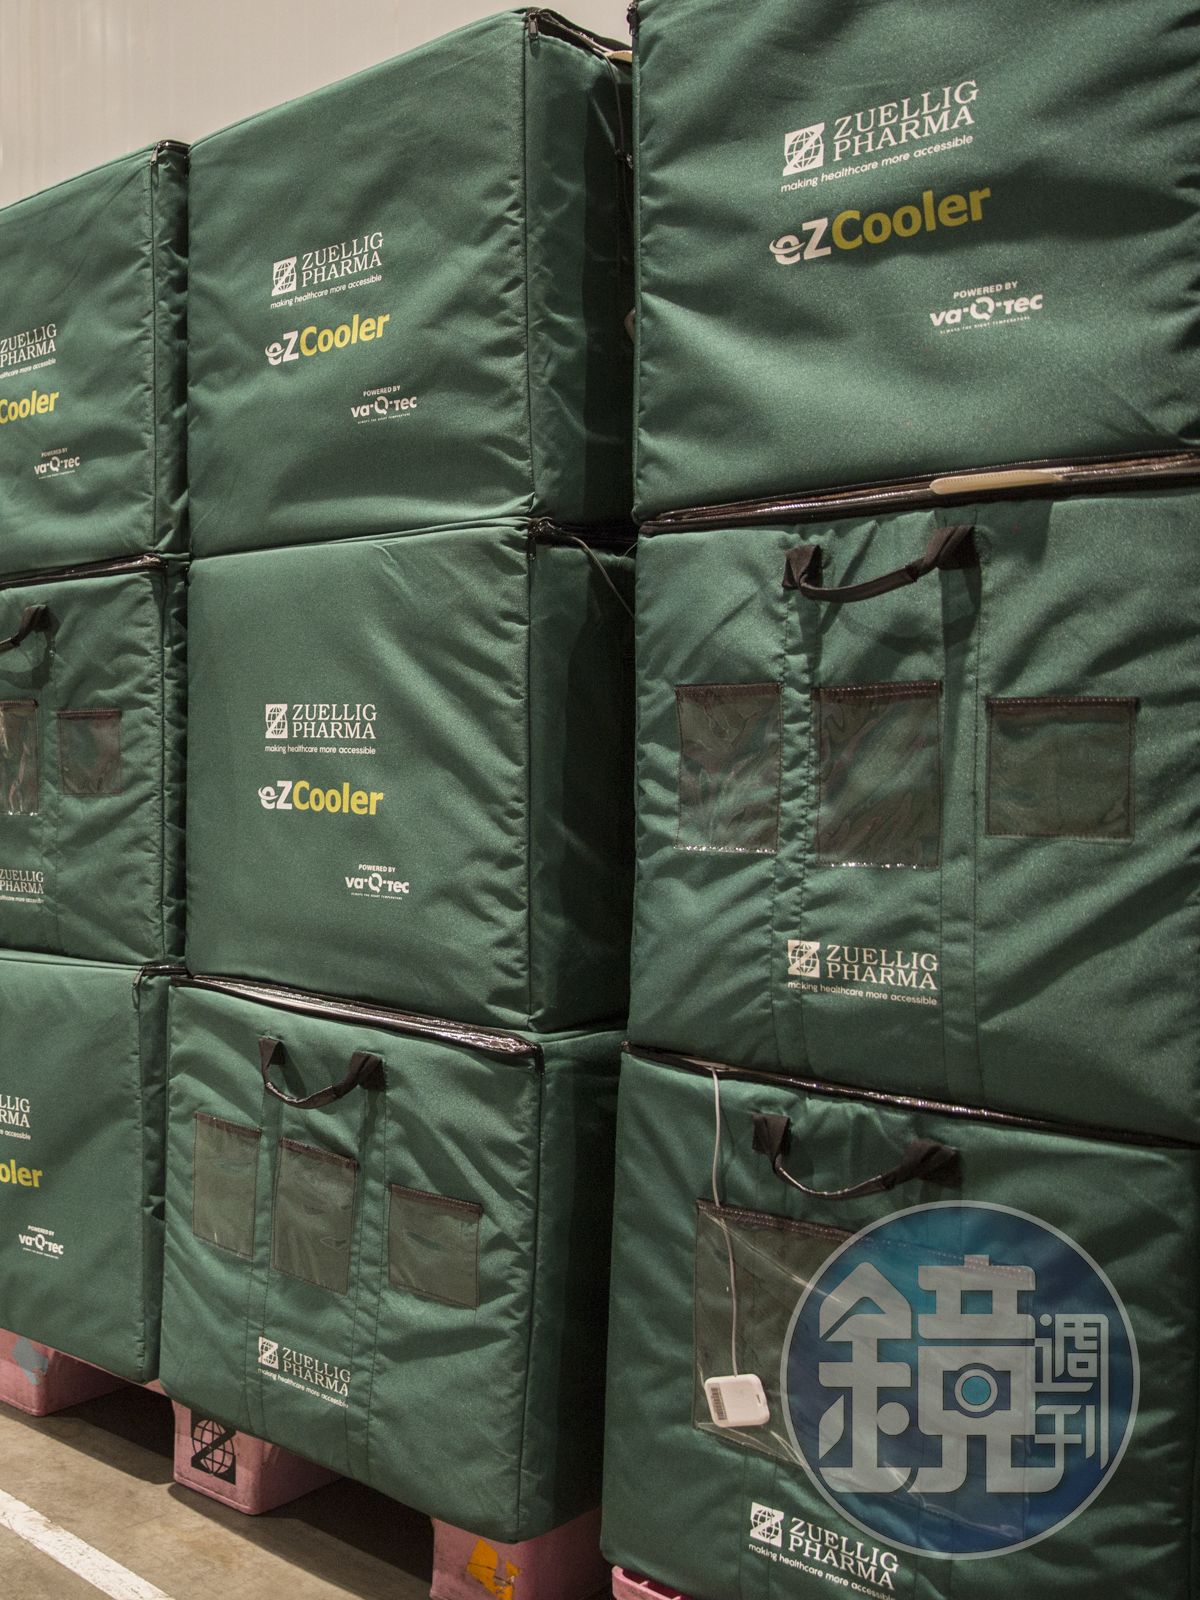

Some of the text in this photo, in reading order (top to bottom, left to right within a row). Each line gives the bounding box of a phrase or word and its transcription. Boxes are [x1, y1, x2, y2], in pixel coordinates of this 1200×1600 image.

[833, 79, 979, 140] ZUELLIG
[832, 105, 975, 162] PHARMA
[780, 134, 974, 193] making healthcare more accessible
[769, 187, 991, 265] eZCooler
[302, 232, 384, 270] ZUELLIG
[301, 251, 382, 287] PHARMA
[270, 274, 382, 309] making healthcare more accessible
[953, 281, 1018, 299] POWERED BY
[0, 323, 57, 354] ZUELLIG
[0, 339, 56, 368] PHARMA
[264, 314, 390, 366] eZCooler
[363, 386, 392, 397] POWERED
[292, 703, 377, 721] ZUELLIG
[292, 721, 376, 739] PHARMA
[265, 745, 376, 755] making healthcare more accessible
[258, 780, 384, 815] eZCooler
[0, 868, 44, 883] ZUELLIG
[358, 864, 387, 872] POWERED
[0, 880, 44, 894] PHARMA
[826, 944, 939, 972] ZUELLIG
[787, 981, 937, 1006] making healthcare more accessible
[826, 962, 938, 990] PHARMA
[282, 1347, 351, 1383] ZUELLIG
[283, 1360, 349, 1397] PHARMA
[788, 1534, 895, 1591] PHARMA
[789, 1517, 900, 1574] ZUELLIG
[748, 1543, 778, 1562] making
[779, 1553, 824, 1577] healthcare
[825, 1572, 849, 1587] more
